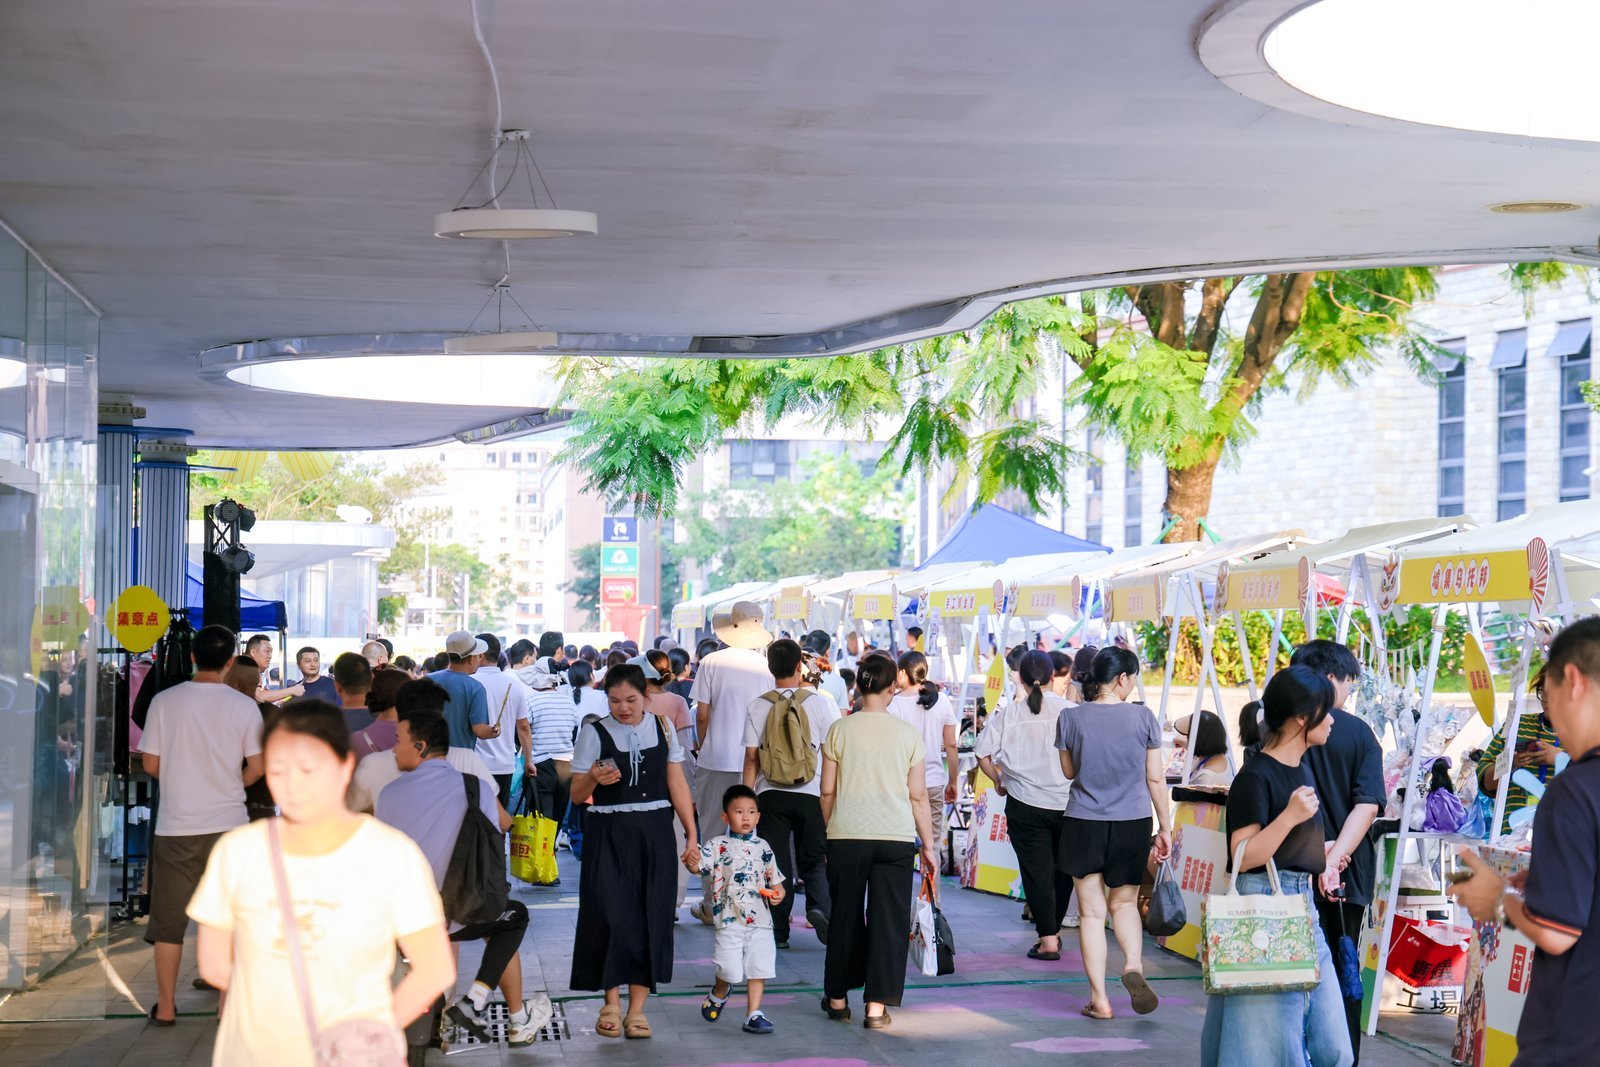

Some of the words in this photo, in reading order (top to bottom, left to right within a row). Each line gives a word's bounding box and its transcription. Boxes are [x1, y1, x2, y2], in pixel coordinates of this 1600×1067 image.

[117, 611, 158, 626] 集章点
[1226, 908, 1257, 917] SUMMER
[1260, 908, 1289, 917] FLOWERS
[1507, 943, 1534, 995] 国
[1396, 987, 1458, 1014] 工場
